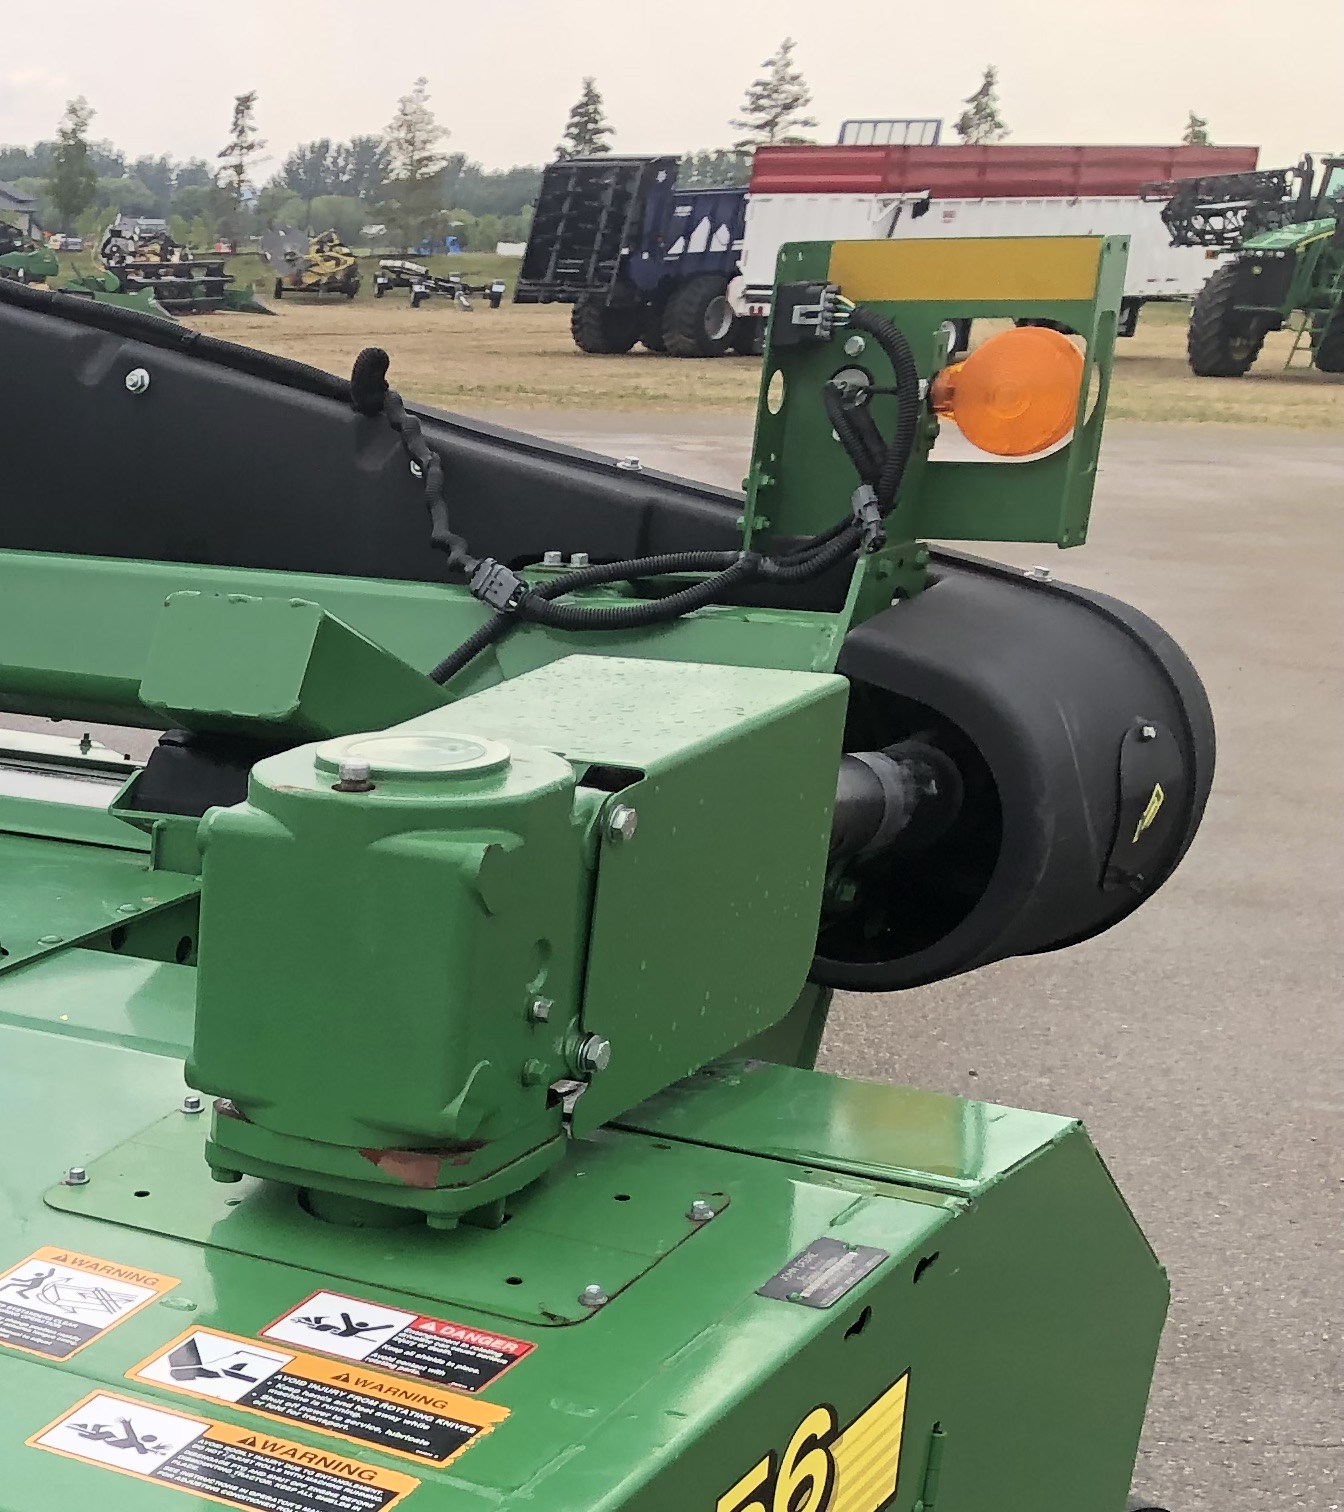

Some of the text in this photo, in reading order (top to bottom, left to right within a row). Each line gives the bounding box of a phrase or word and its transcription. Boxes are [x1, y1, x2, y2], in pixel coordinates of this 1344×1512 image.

[72, 1257, 159, 1286] WARNING
[381, 1343, 404, 1354] Keep
[414, 1352, 446, 1365] shields
[440, 1325, 519, 1353] DANGER
[370, 1351, 447, 1376] Avoid contact with
[264, 1402, 285, 1412] fold
[285, 1408, 301, 1417] for
[267, 1387, 309, 1403] machine
[273, 1374, 477, 1434] AVOID INJURY FROM ROTATING KNIVES
[275, 1382, 431, 1430] Keep hands and feet away while
[353, 1377, 449, 1410] WARNING
[259, 1393, 284, 1405] Shut
[284, 1400, 299, 1409] off
[299, 1404, 331, 1418] power
[331, 1413, 343, 1421] to
[385, 1428, 431, 1446] lubricate
[197, 1438, 223, 1449] AVOID
[253, 1454, 283, 1466] INJURY
[283, 1463, 301, 1472] DUE
[204, 1447, 221, 1455] NOT
[254, 1461, 282, 1473] ROLLS
[282, 1469, 304, 1479] WITH
[304, 1475, 342, 1490] MACHINE
[261, 1439, 379, 1482] WARNING
[156, 1470, 174, 1478] FOR
[174, 1475, 220, 1492] ADJUSTING
[220, 1489, 276, 1509] CONDITIONER
[162, 1465, 179, 1474] SEE
[179, 1470, 238, 1491] INSTRUCTIONS
[248, 1490, 302, 1509] OPERATOR'S
[230, 1463, 247, 1471] PTO
[247, 1468, 266, 1477] AND
[266, 1473, 289, 1484] SHUT
[289, 1480, 307, 1489] OFF
[307, 1485, 339, 1498] ENGINE
[339, 1494, 375, 1509] BEFORE
[274, 1482, 297, 1492] KEEP
[297, 1489, 315, 1498] ALL
[315, 1494, 351, 1508] SHIELDS
